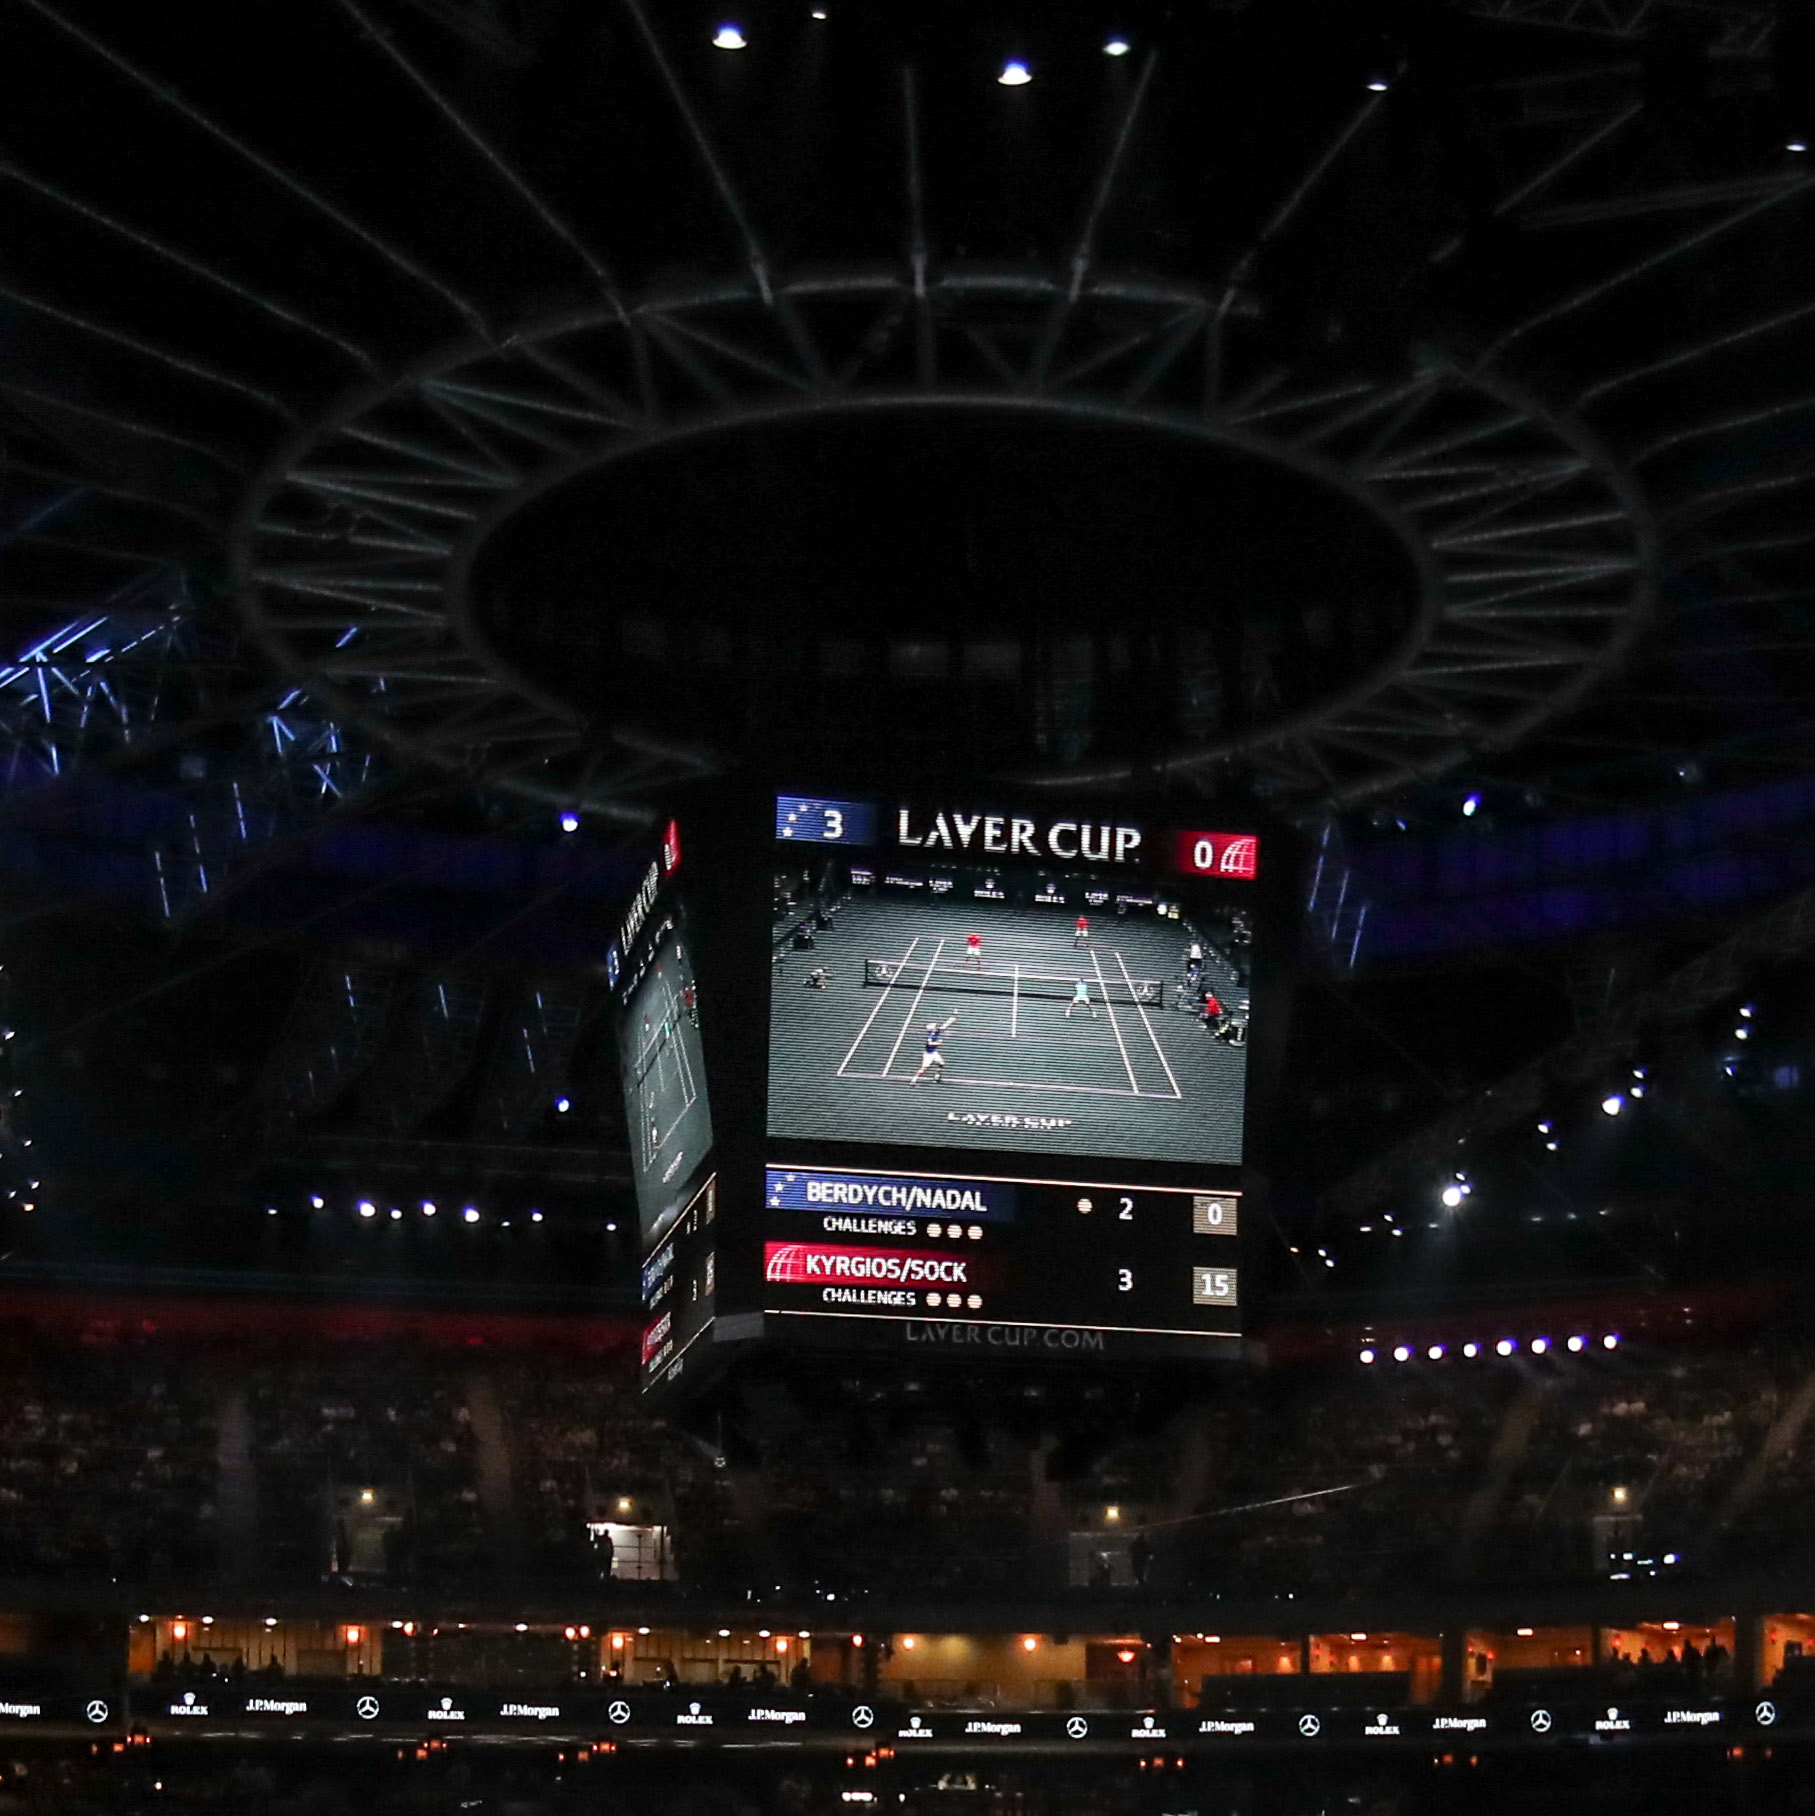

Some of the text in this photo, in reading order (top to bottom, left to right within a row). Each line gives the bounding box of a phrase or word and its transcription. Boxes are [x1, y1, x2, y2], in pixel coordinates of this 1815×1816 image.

[824, 810, 842, 838] 3
[898, 809, 1142, 862] LAVER CUP
[1194, 841, 1213, 868] 0
[807, 1181, 1222, 1226] BERDYCH/NADAL 2 0
[823, 1216, 917, 1237] CHALLENGES
[806, 1254, 1229, 1297] KYRGIOS/SOCK 3 15
[822, 1287, 917, 1307] CHALLENGES
[905, 1322, 1105, 1351] LAVER CUP.COM
[171, 1705, 208, 1715] ROLEX
[246, 1699, 306, 1714] J.P.Morgan
[500, 1704, 559, 1719] J.P.Morgan
[428, 1710, 465, 1719] ROLEX
[677, 1715, 713, 1724] ROLEX
[748, 1709, 805, 1724] J.P.Morgan
[1664, 1711, 1719, 1725] J.P.Morgan
[965, 1722, 1021, 1735] J.P.Morgan
[1199, 1721, 1254, 1734] J.P.Morgan
[1365, 1724, 1399, 1734] ROLEX
[1433, 1718, 1486, 1731] J.P.Morgan
[1596, 1720, 1630, 1730] ROLEX
[899, 1729, 933, 1737] ROLEX
[1132, 1728, 1166, 1737] ROLEX
